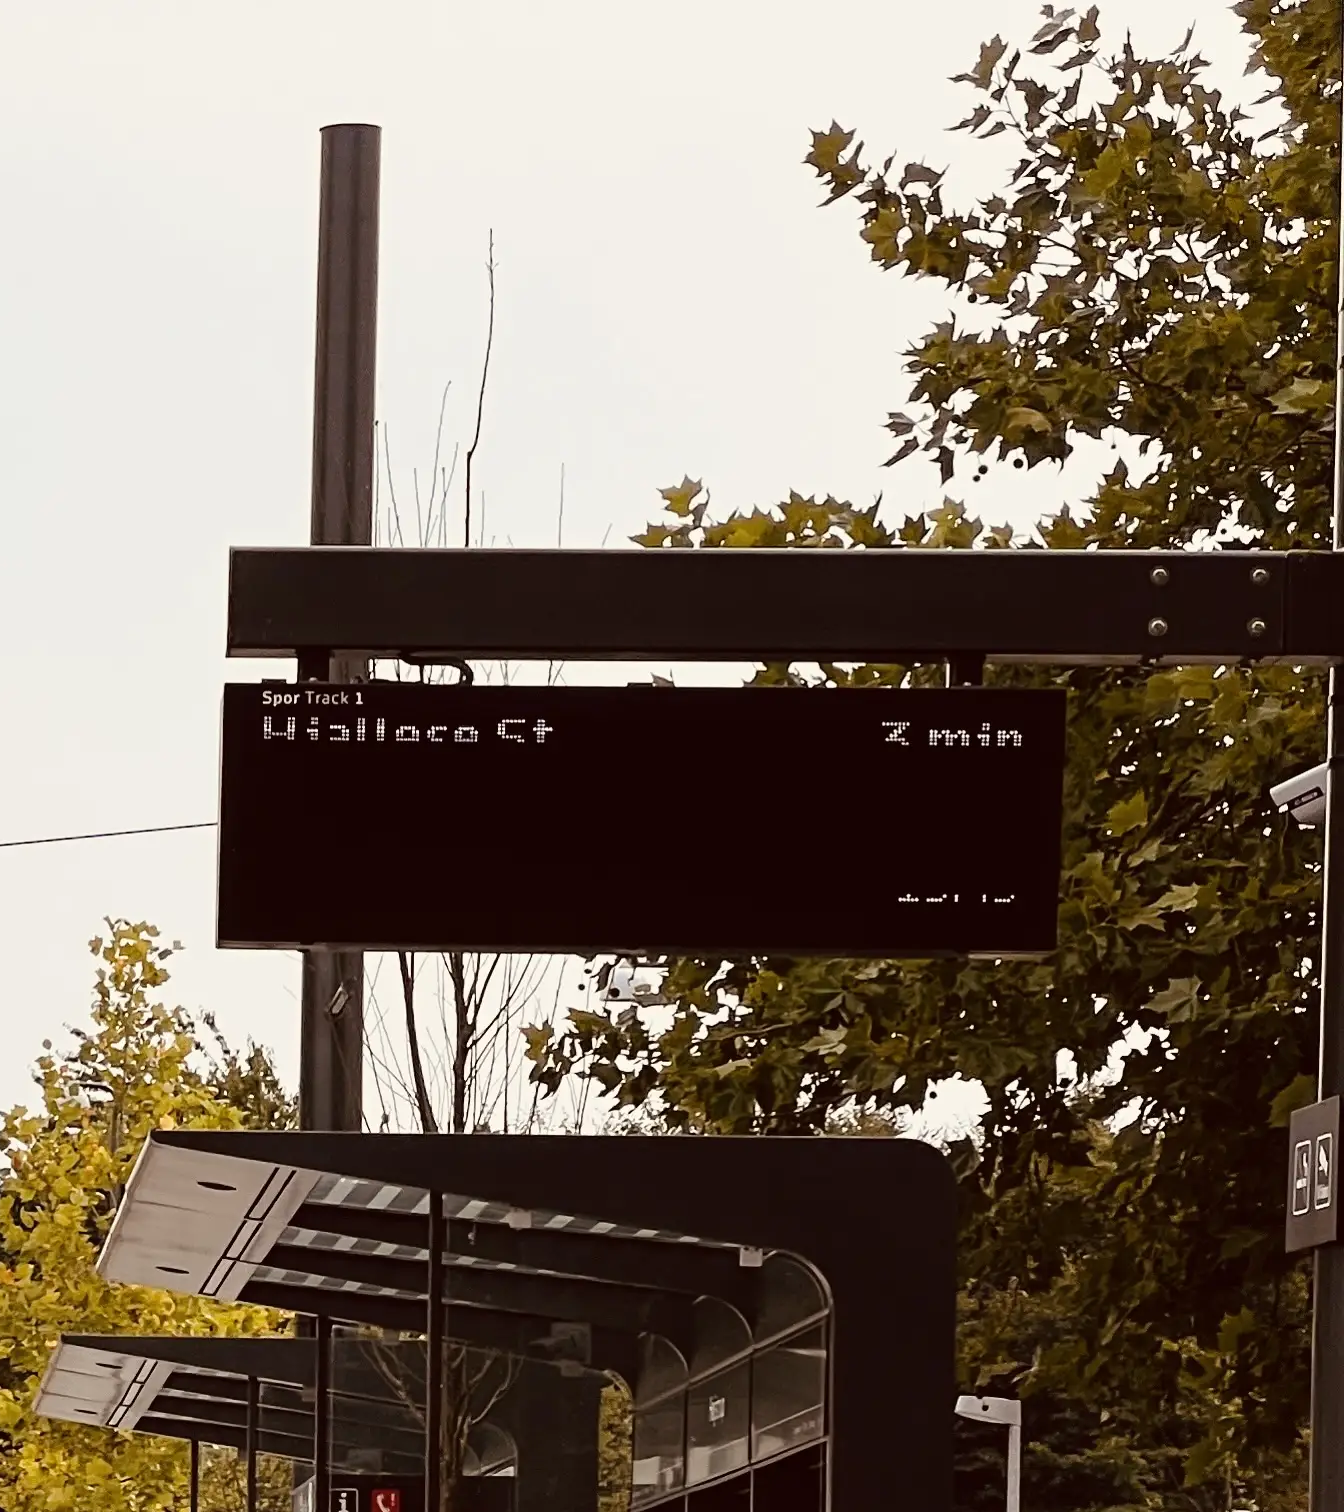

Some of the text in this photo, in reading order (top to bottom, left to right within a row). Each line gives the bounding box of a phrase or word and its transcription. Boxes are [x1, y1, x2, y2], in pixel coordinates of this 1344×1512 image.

[262, 691, 364, 706] Spor Track 1
[928, 721, 1023, 748] min
